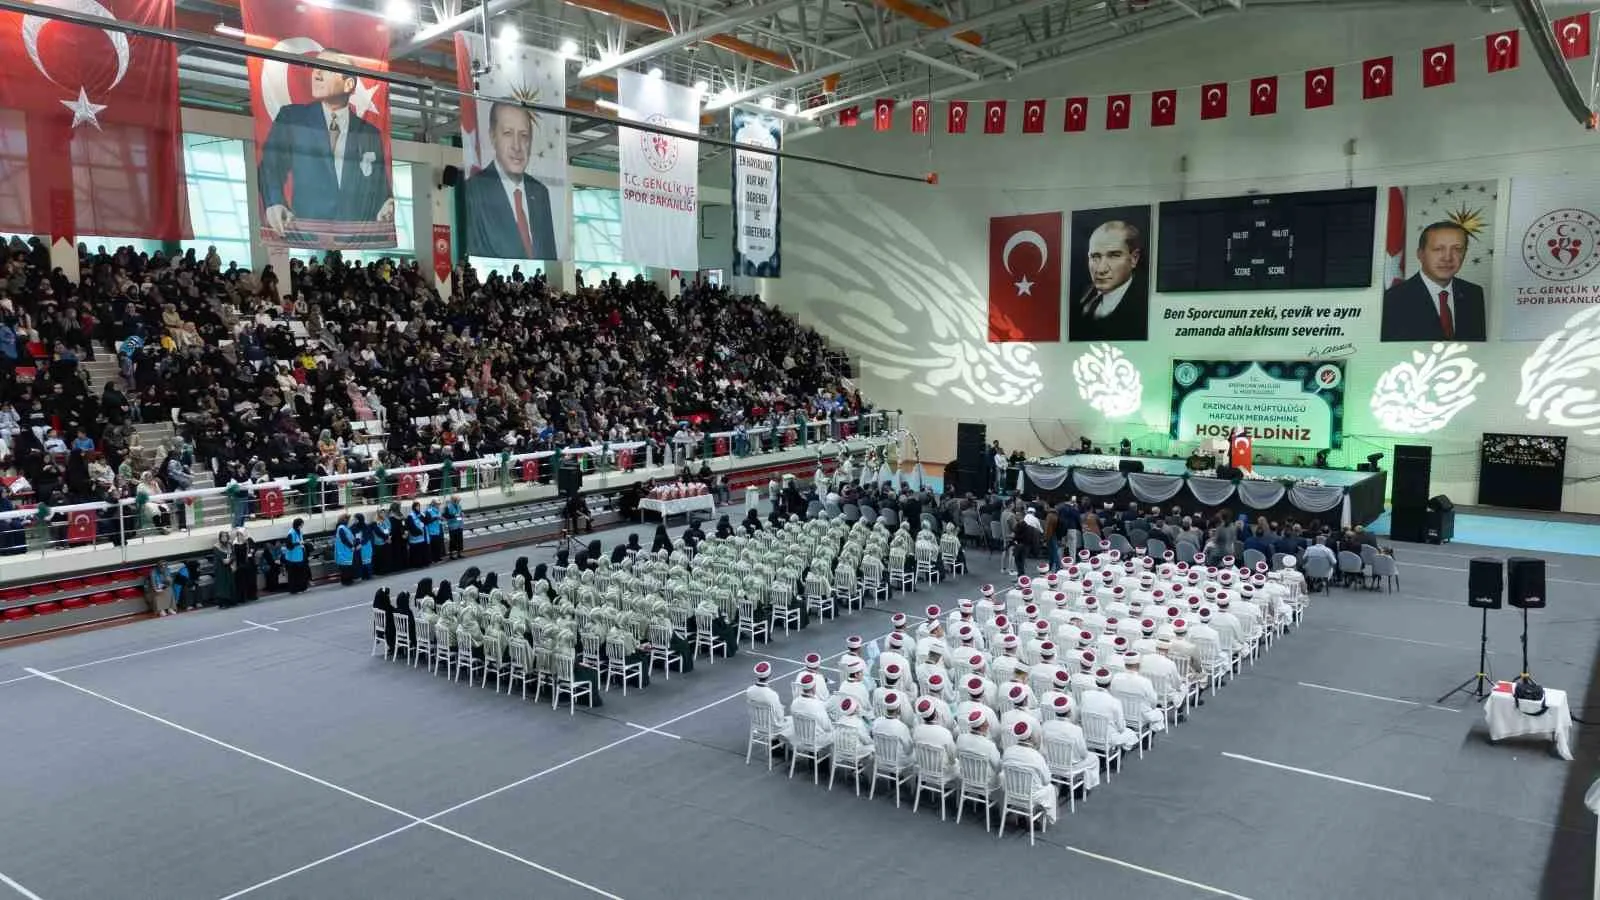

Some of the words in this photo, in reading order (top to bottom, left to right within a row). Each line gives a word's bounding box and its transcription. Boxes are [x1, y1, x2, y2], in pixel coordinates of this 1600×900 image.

[624, 188, 648, 204] SPOR
[1517, 287, 1537, 295] T.C.
[1540, 284, 1589, 295] GENÇLİK
[1517, 297, 1544, 305] SPOR
[1547, 294, 1600, 305] BAKANLIĞ
[1163, 308, 1185, 320] Ben
[1186, 307, 1247, 321] Sporcunun
[1249, 307, 1278, 320] zeki,
[1281, 306, 1313, 320] çevik
[1316, 308, 1330, 318] ve
[1333, 307, 1361, 319] aynı
[1175, 325, 1226, 337] zamanda
[1228, 324, 1290, 337] ahlaklısını
[1292, 324, 1345, 336] severim.
